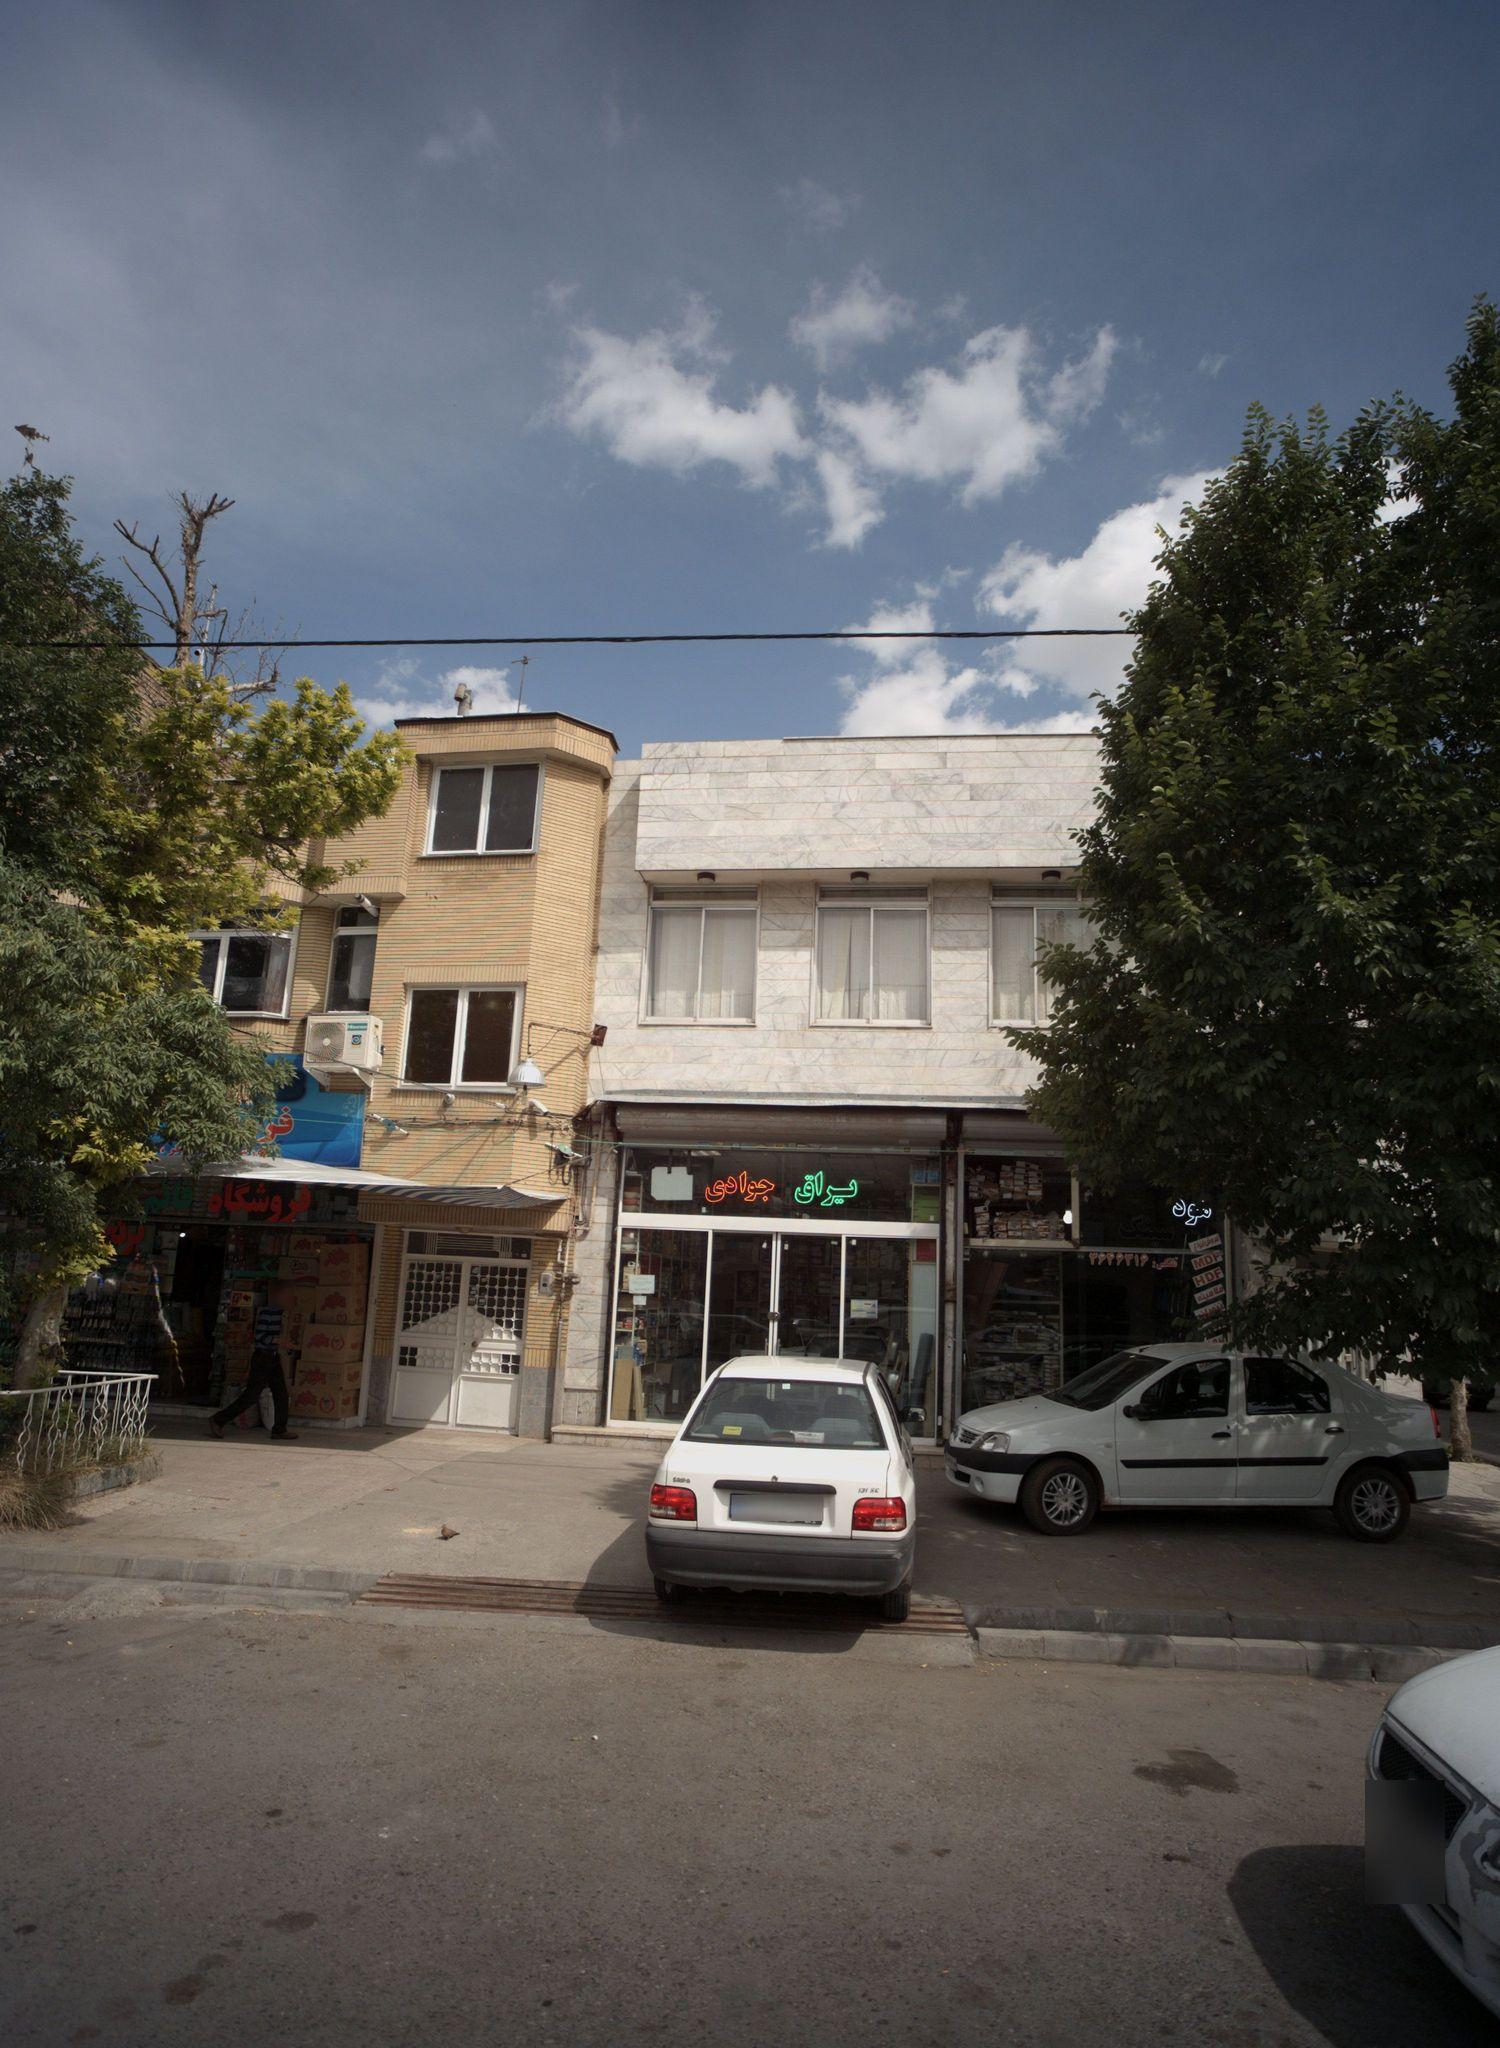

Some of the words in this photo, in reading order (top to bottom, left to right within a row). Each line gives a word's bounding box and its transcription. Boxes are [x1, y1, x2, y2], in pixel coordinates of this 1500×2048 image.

[208, 1182, 314, 1224] فروشگاه
[705, 1170, 775, 1203] جوادی
[794, 1170, 859, 1206] یراق
[1195, 1267, 1224, 1287] HDF
